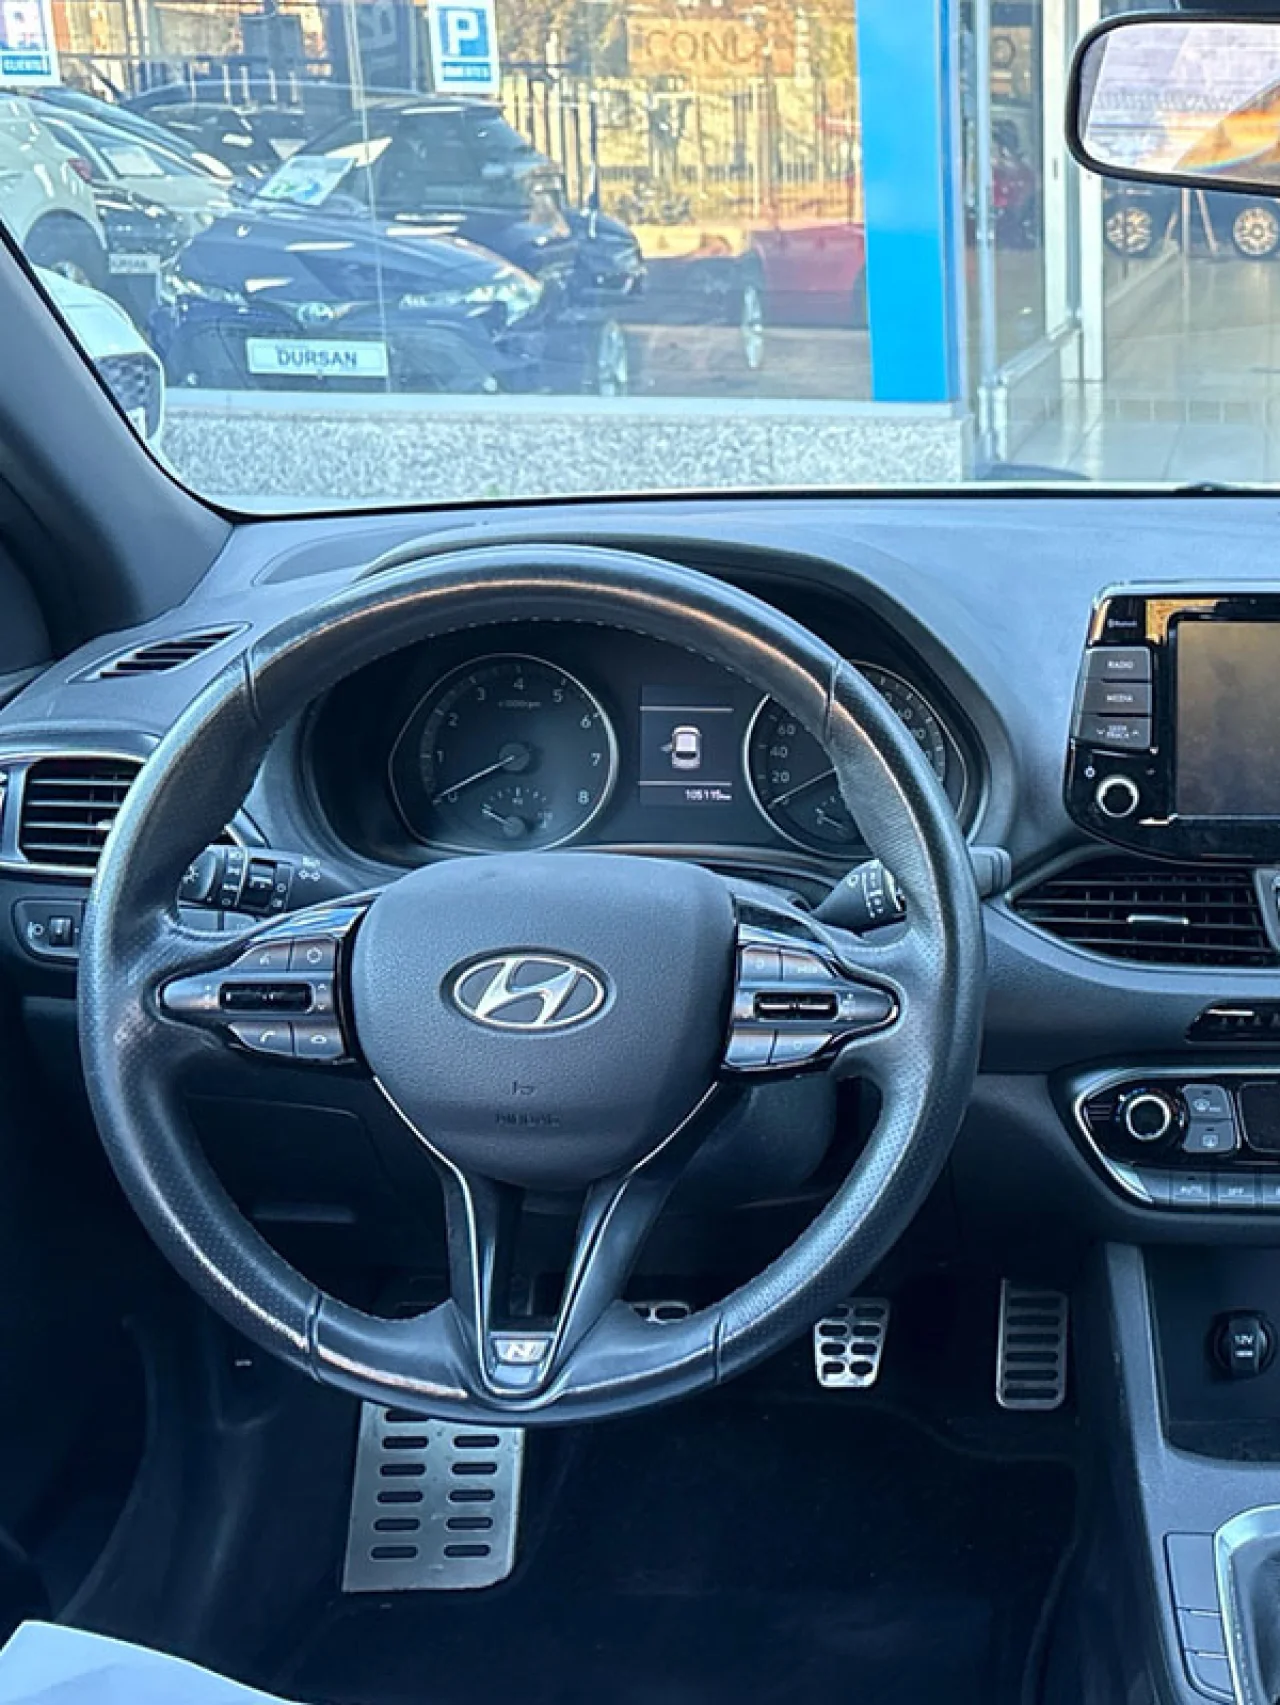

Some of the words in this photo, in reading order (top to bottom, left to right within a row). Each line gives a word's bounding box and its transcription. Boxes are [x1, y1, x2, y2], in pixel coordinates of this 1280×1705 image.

[447, 9, 479, 55] P
[277, 349, 357, 367] DURSAN
[1107, 660, 1134, 669] RADIO
[513, 678, 524, 690] 4
[553, 689, 563, 703] 5
[1106, 693, 1134, 703] MEDIA
[580, 715, 592, 729] 6
[777, 724, 796, 737] 60
[590, 752, 601, 767] 7
[769, 747, 788, 759] 40
[771, 770, 791, 784] 20
[577, 790, 590, 804] 8
[1234, 1335, 1255, 1346] 12V
